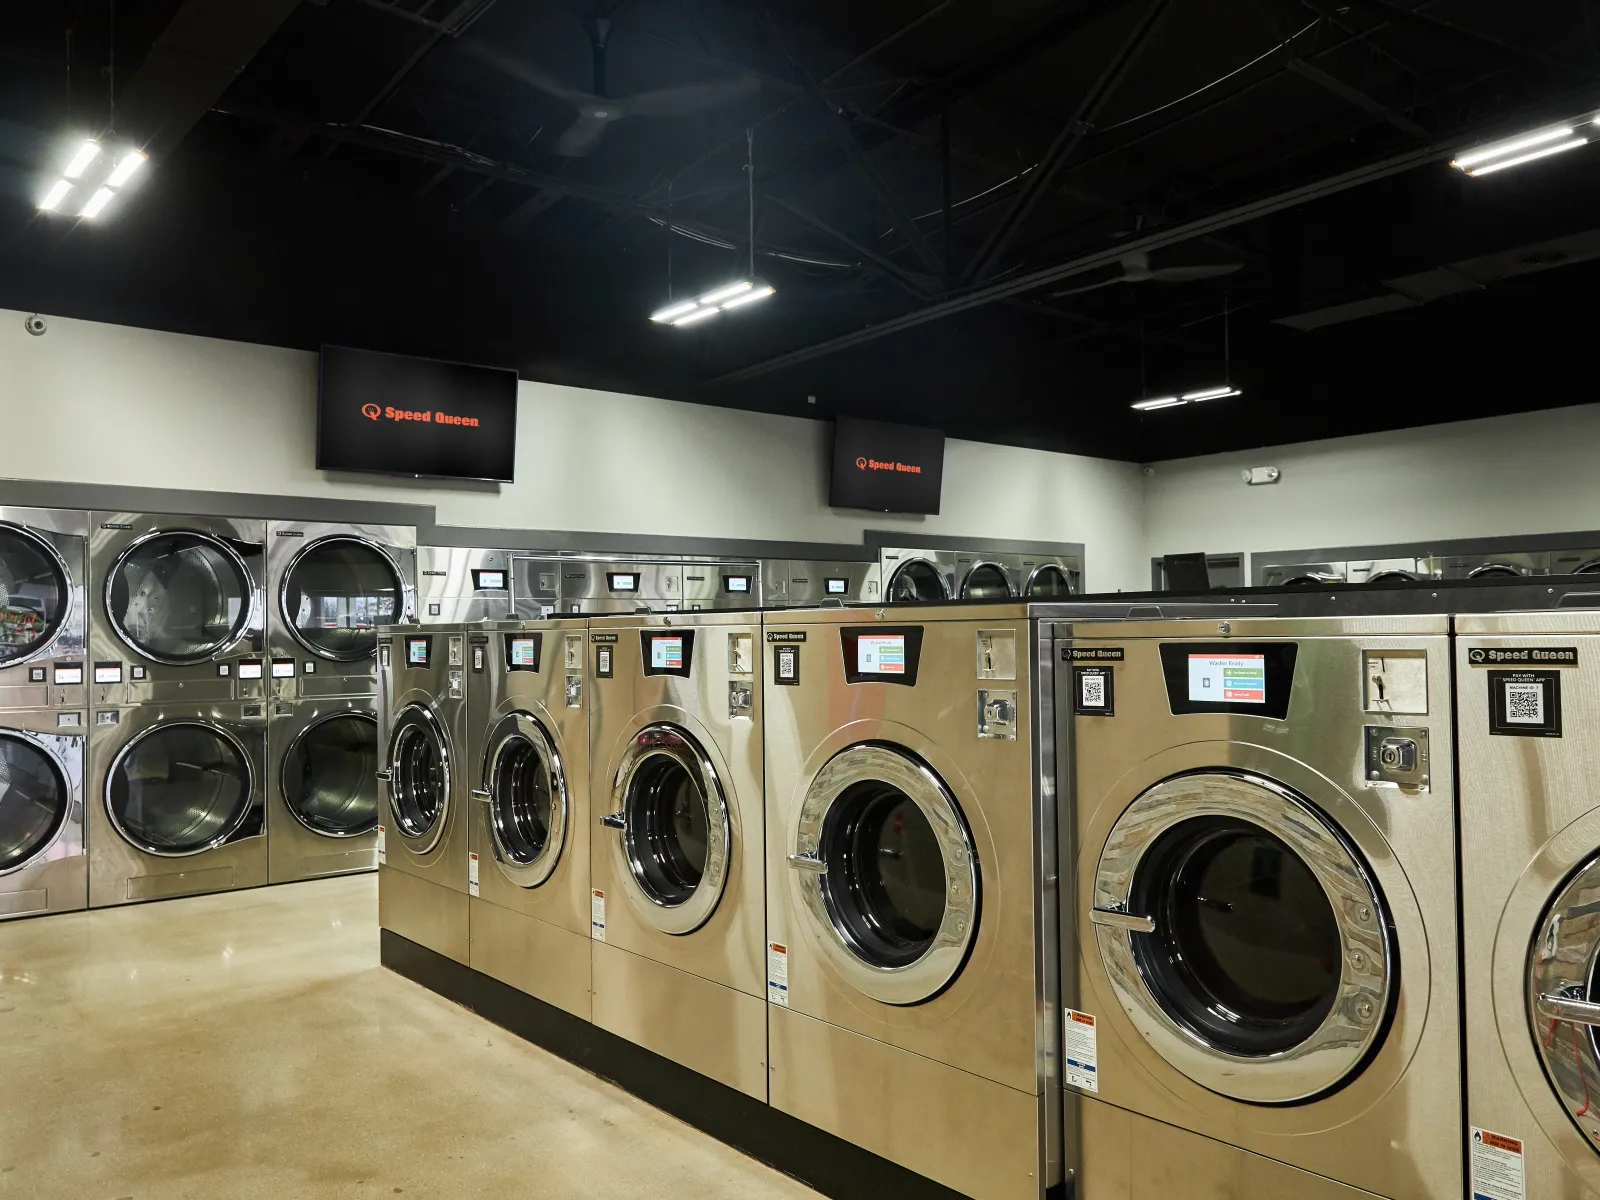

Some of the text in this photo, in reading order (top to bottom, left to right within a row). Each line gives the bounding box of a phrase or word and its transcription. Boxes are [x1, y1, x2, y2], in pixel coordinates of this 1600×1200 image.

[385, 406, 432, 422] Speed
[435, 412, 479, 427] Queen
[868, 459, 895, 471] Speed
[896, 462, 921, 474] Queen
[1072, 650, 1095, 659] Speed
[1097, 650, 1121, 658] Queen
[1488, 650, 1529, 662] Speed
[1532, 650, 1574, 660] Queen
